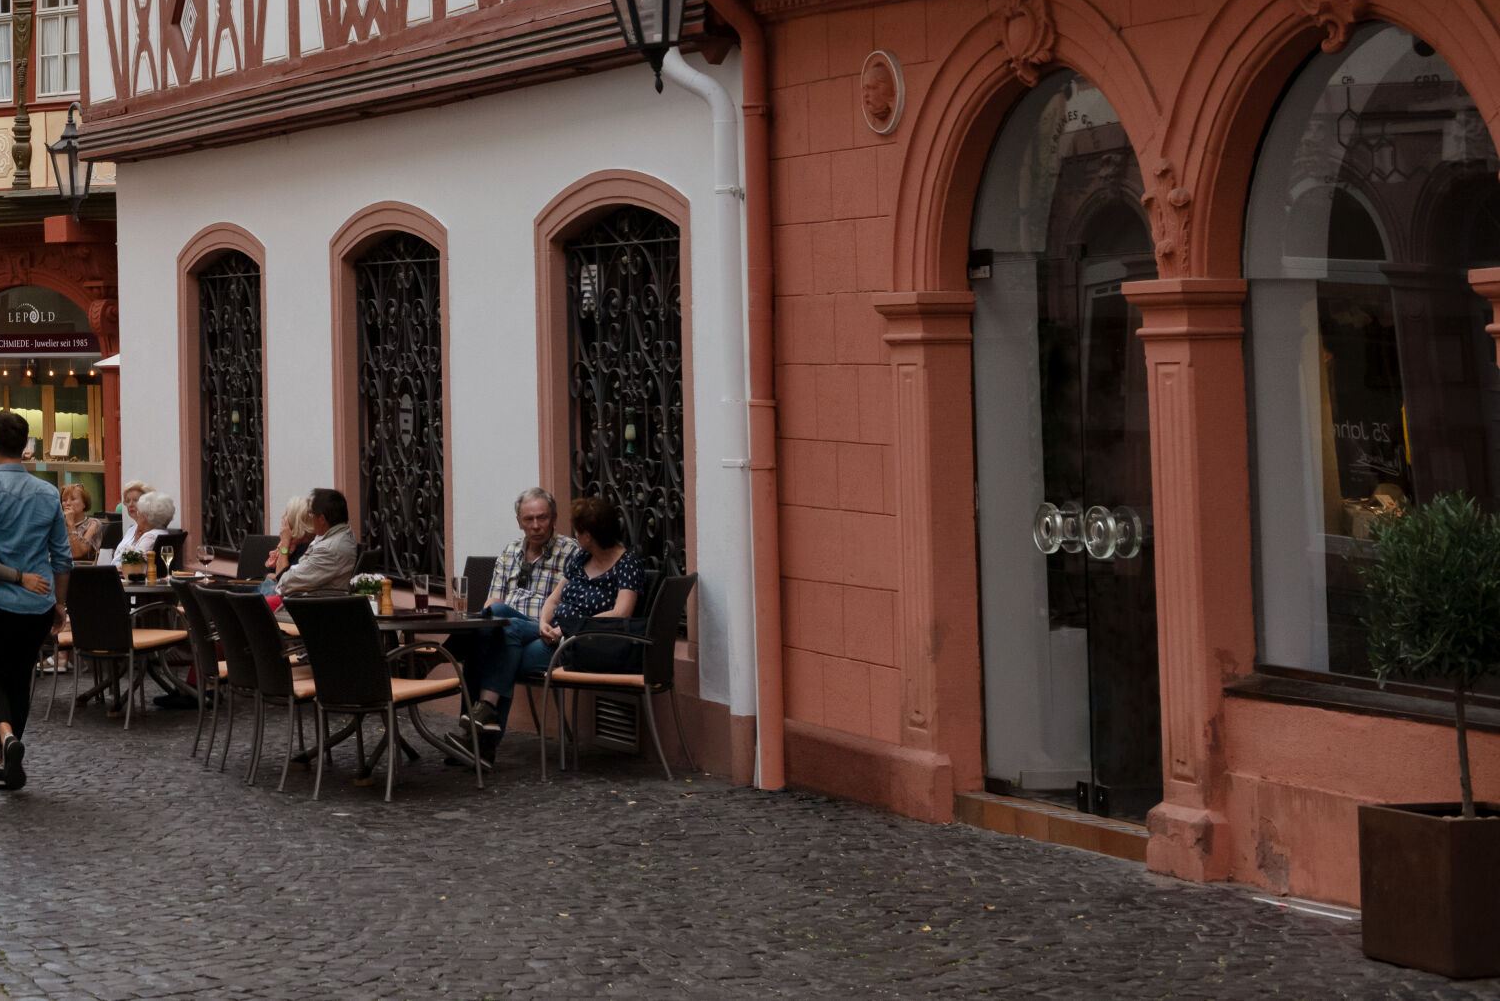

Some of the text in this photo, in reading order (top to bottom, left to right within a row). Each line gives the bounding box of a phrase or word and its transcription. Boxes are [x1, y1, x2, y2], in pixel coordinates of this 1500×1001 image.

[8, 309, 56, 324] LEPOLD
[34, 339, 59, 348] Juwelier
[60, 339, 71, 348] seit
[72, 338, 88, 347] 1985
